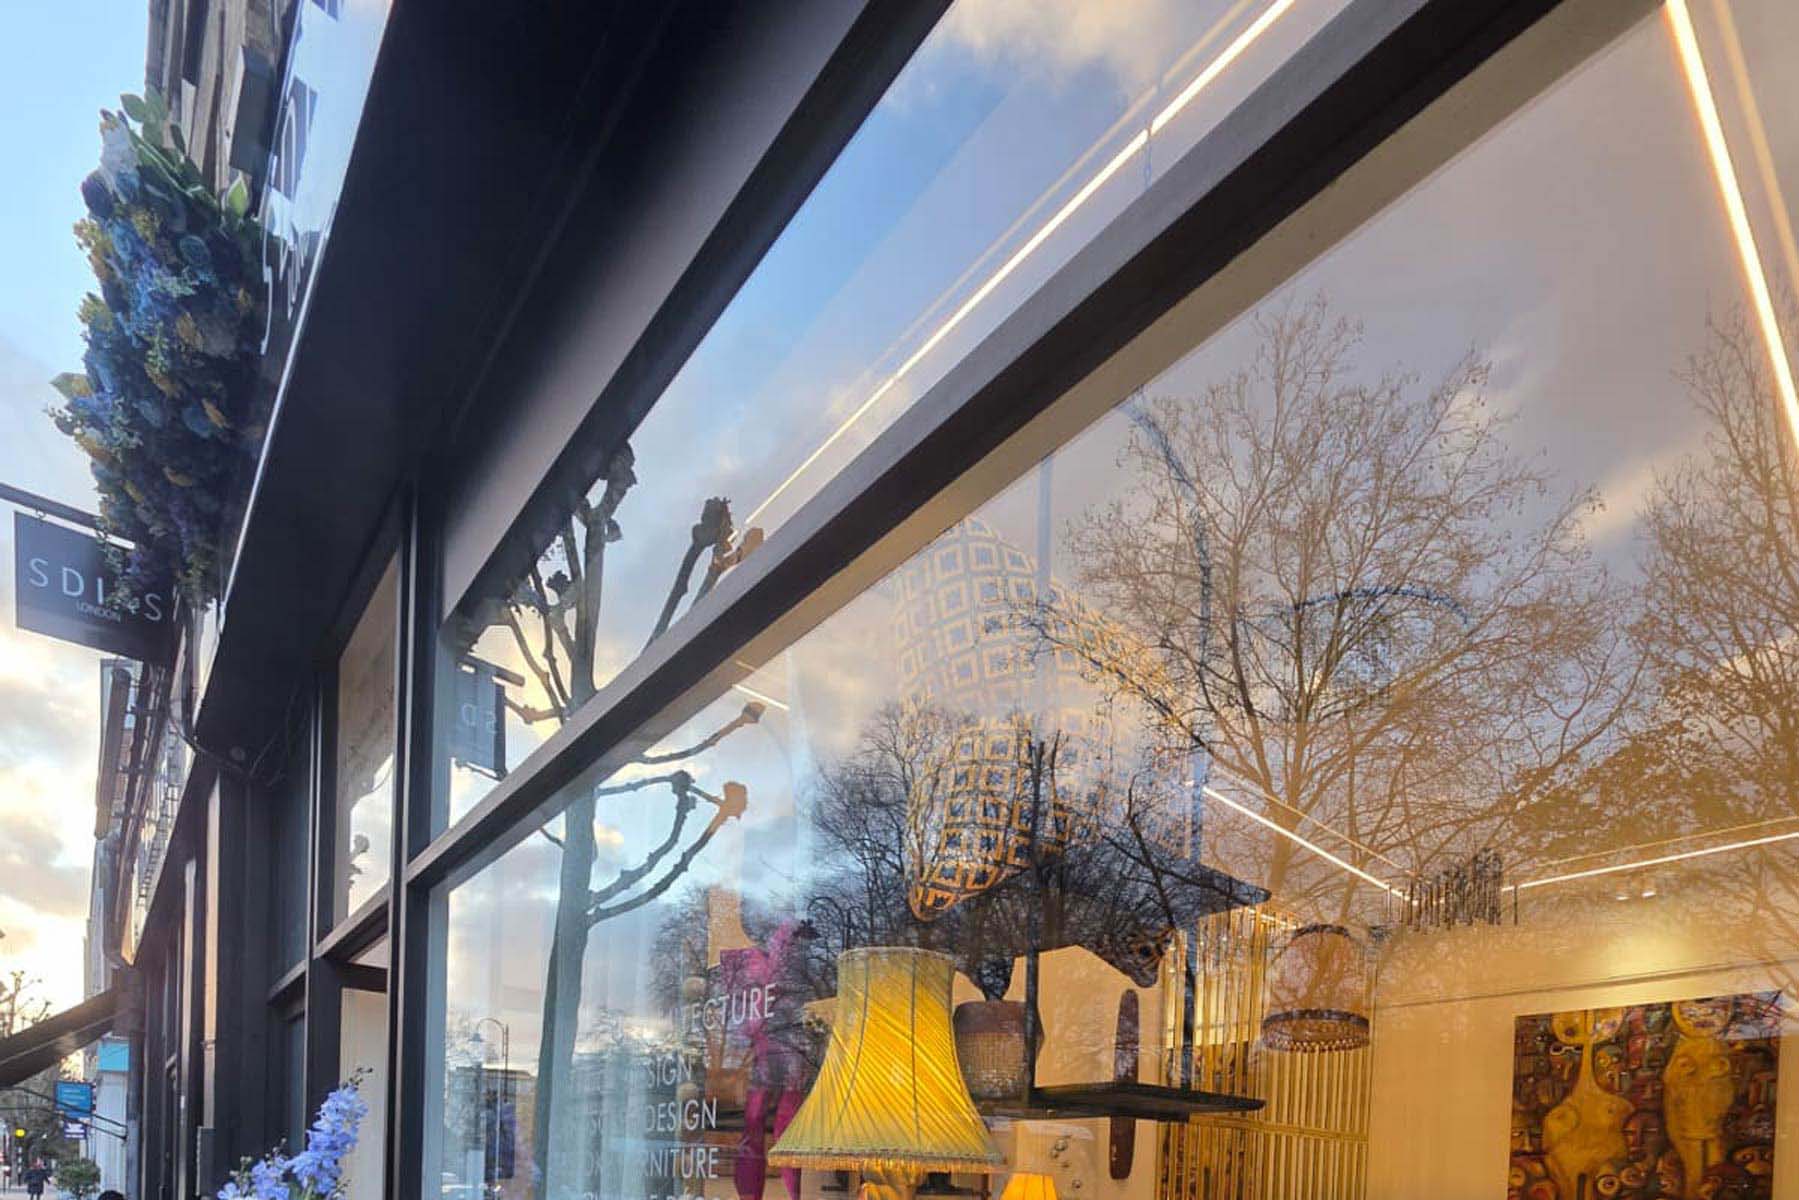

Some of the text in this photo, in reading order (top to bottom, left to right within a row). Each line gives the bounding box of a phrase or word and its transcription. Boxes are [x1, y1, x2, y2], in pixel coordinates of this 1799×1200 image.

[29, 558, 163, 621] SDIS
[639, 1053, 693, 1089] SIGN
[645, 1096, 718, 1132] DESIGN
